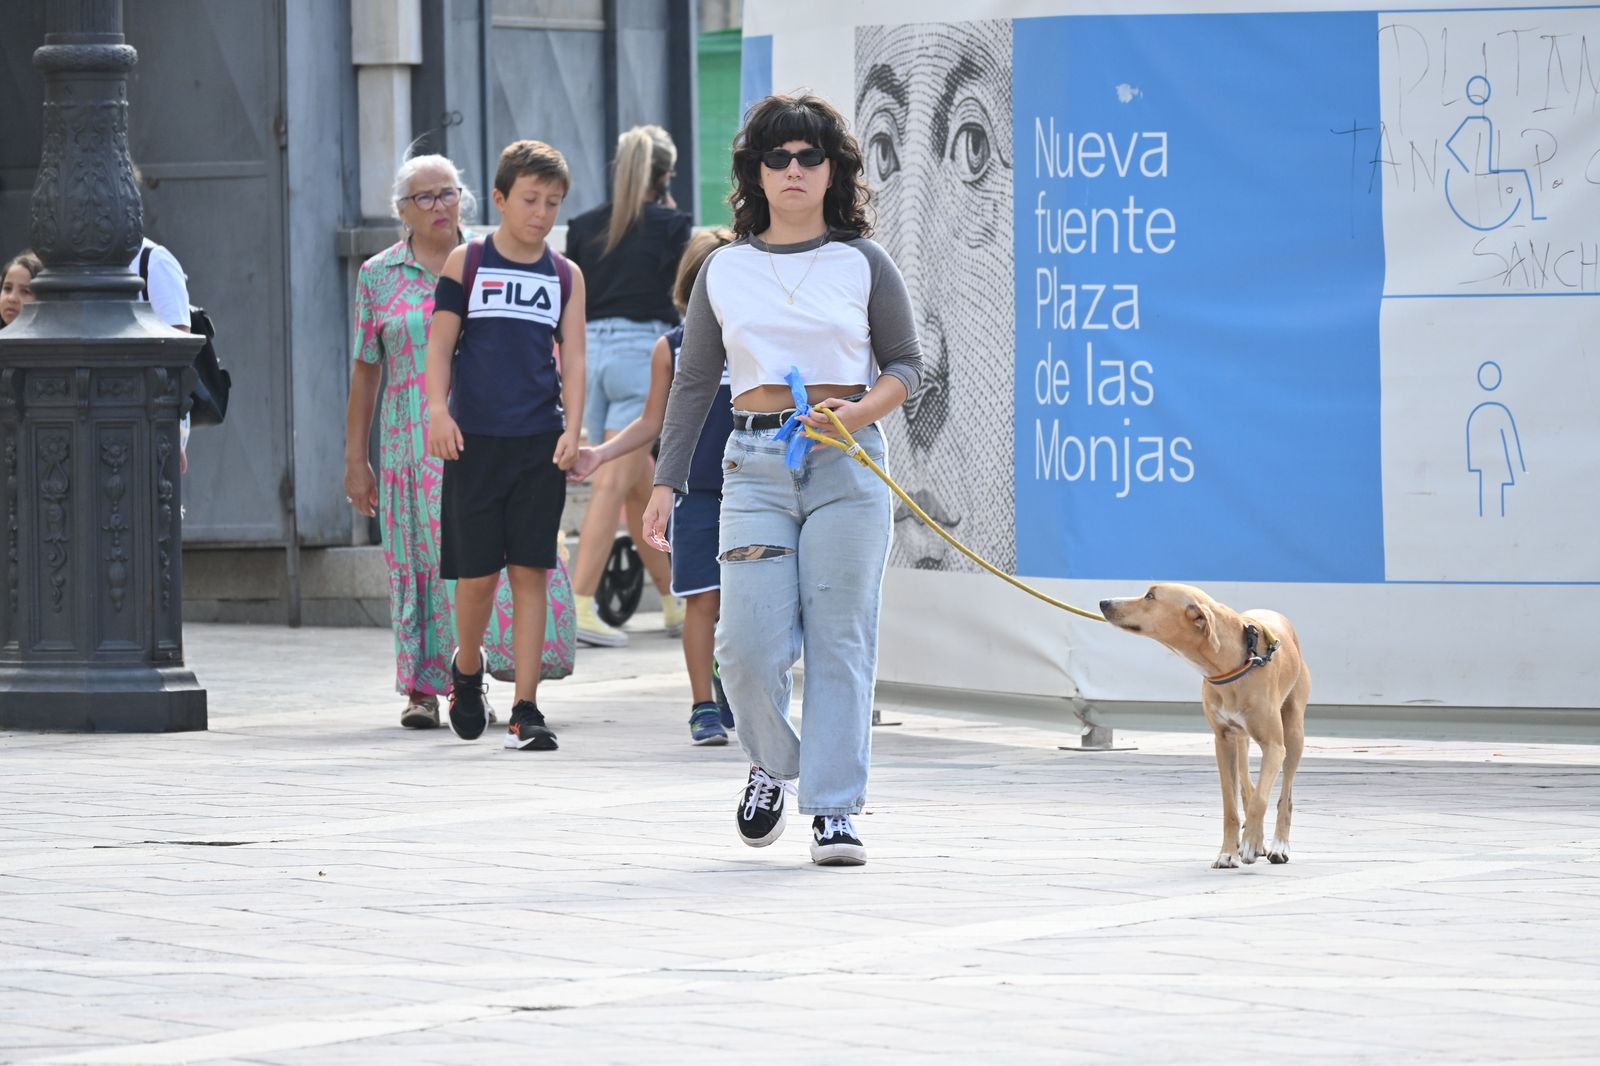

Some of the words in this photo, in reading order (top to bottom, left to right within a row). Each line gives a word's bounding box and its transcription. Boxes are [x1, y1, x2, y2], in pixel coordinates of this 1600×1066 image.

[1035, 117, 1168, 178] Nueva
[1035, 191, 1177, 254] fuente
[481, 279, 552, 311] FILA
[1036, 266, 1140, 330] Plaza
[1035, 342, 1070, 406] de
[1087, 341, 1155, 406] las
[1035, 417, 1195, 499] Monjas
